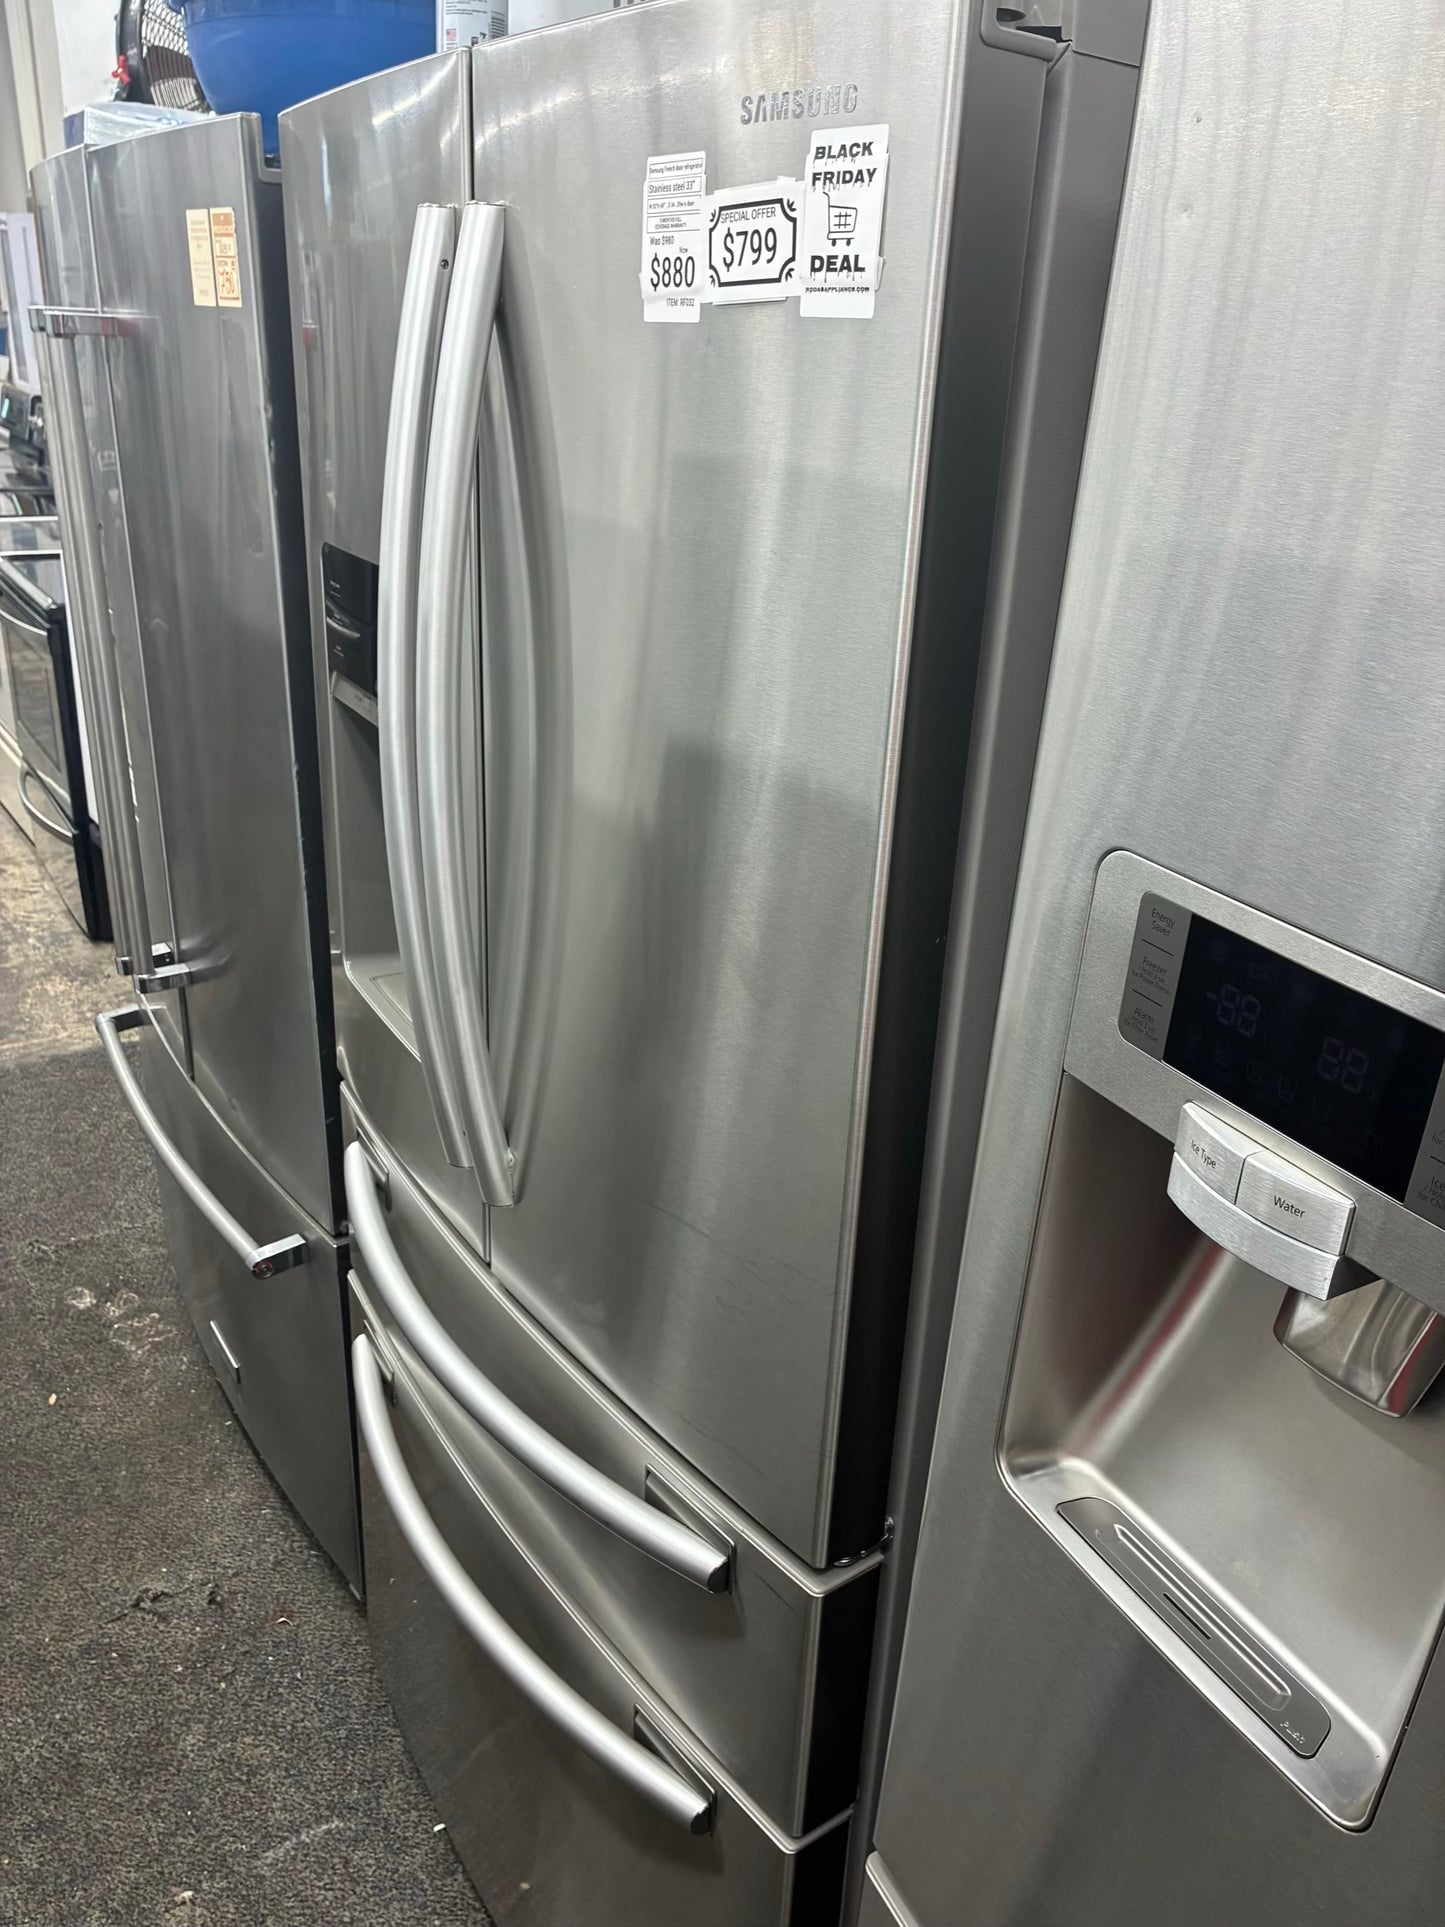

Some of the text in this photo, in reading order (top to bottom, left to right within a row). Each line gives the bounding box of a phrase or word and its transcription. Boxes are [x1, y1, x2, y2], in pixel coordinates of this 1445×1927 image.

[740, 83, 858, 125] SAMSUNG
[814, 141, 874, 162] BLACK
[648, 184, 672, 194] Stainless
[672, 179, 686, 192] steel
[811, 168, 877, 188] FRIDAY
[720, 206, 776, 224] SPECIAL OFFER
[649, 236, 661, 246] Was
[722, 227, 777, 272] $799
[650, 252, 695, 292] $880
[810, 254, 866, 276] DEAL
[1151, 908, 1176, 930] Energy
[1151, 920, 1171, 937] Saver
[1142, 956, 1168, 977] Freezer
[1133, 1007, 1155, 1026] Alarm
[1190, 1139, 1217, 1170] Ice Type
[1273, 1194, 1306, 1219] Water
